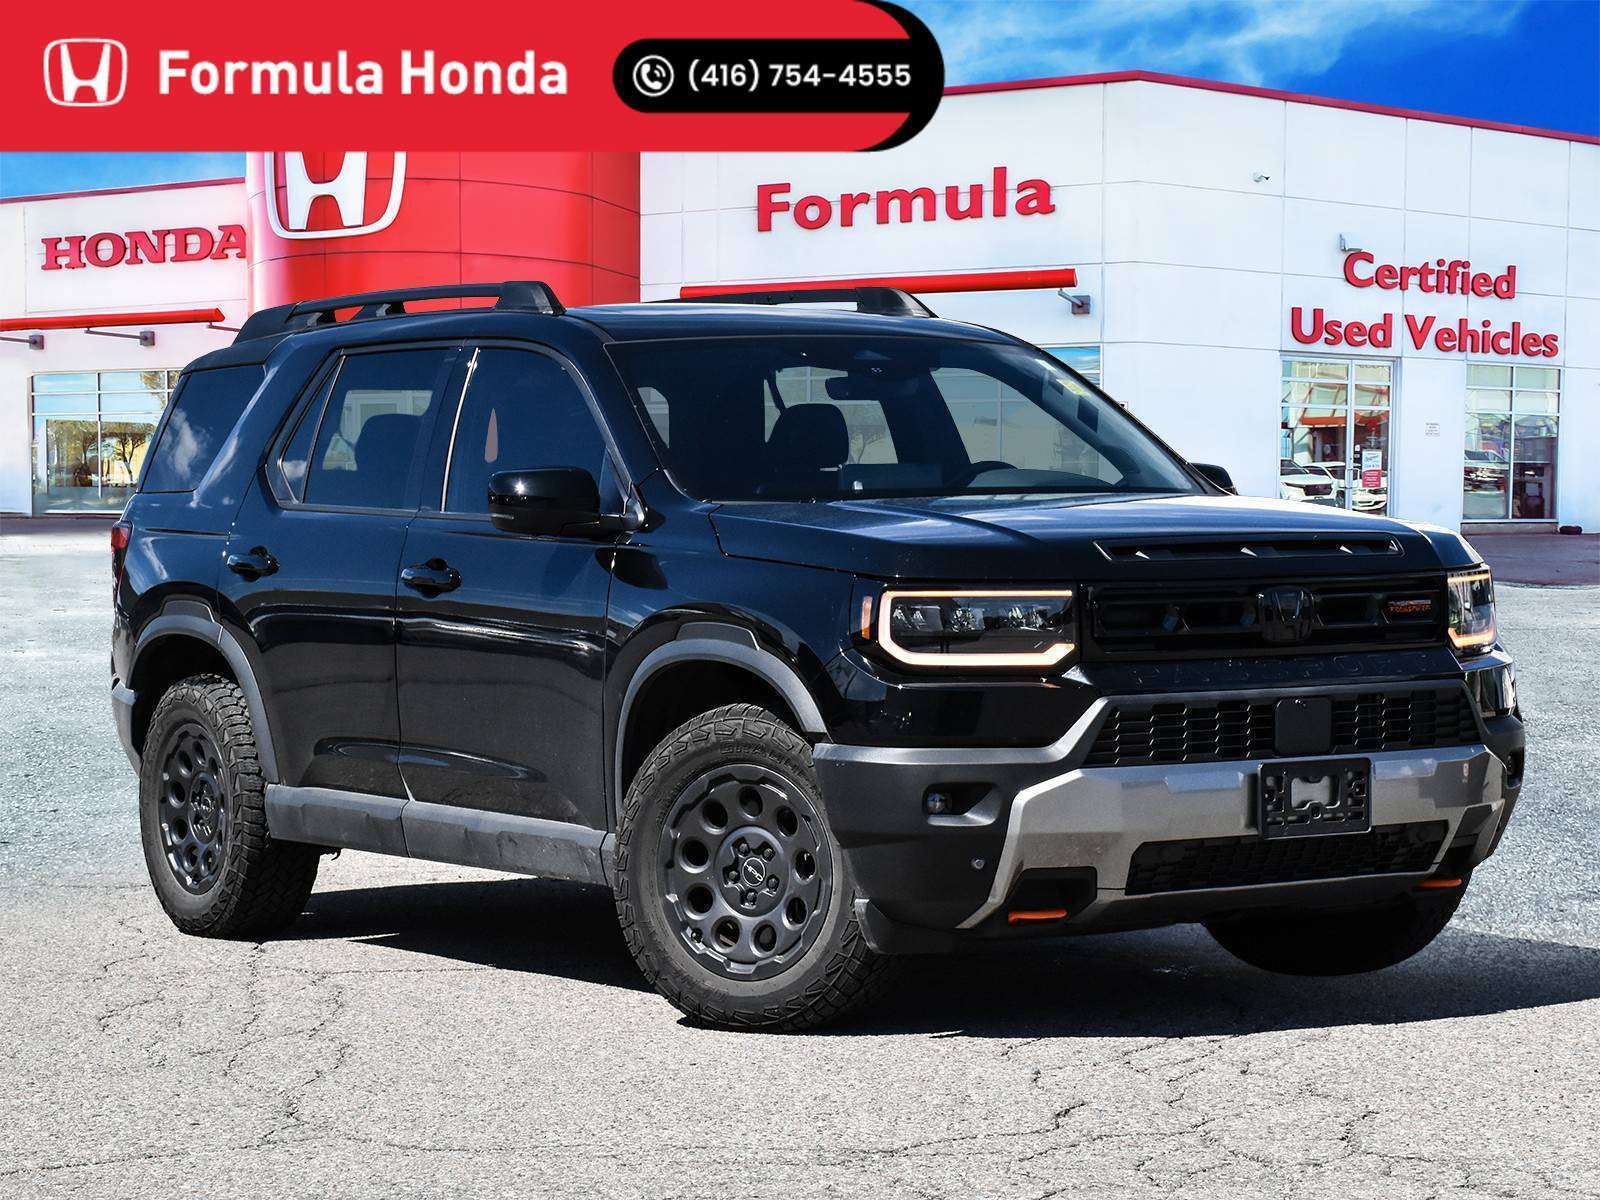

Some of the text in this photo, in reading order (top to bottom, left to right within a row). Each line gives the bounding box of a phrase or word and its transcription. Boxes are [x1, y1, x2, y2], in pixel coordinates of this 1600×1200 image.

[757, 166, 1056, 233] Formula
[42, 223, 247, 271] HONDA
[1343, 251, 1516, 299] Certified
[1291, 307, 1559, 358] Used Vehicles
